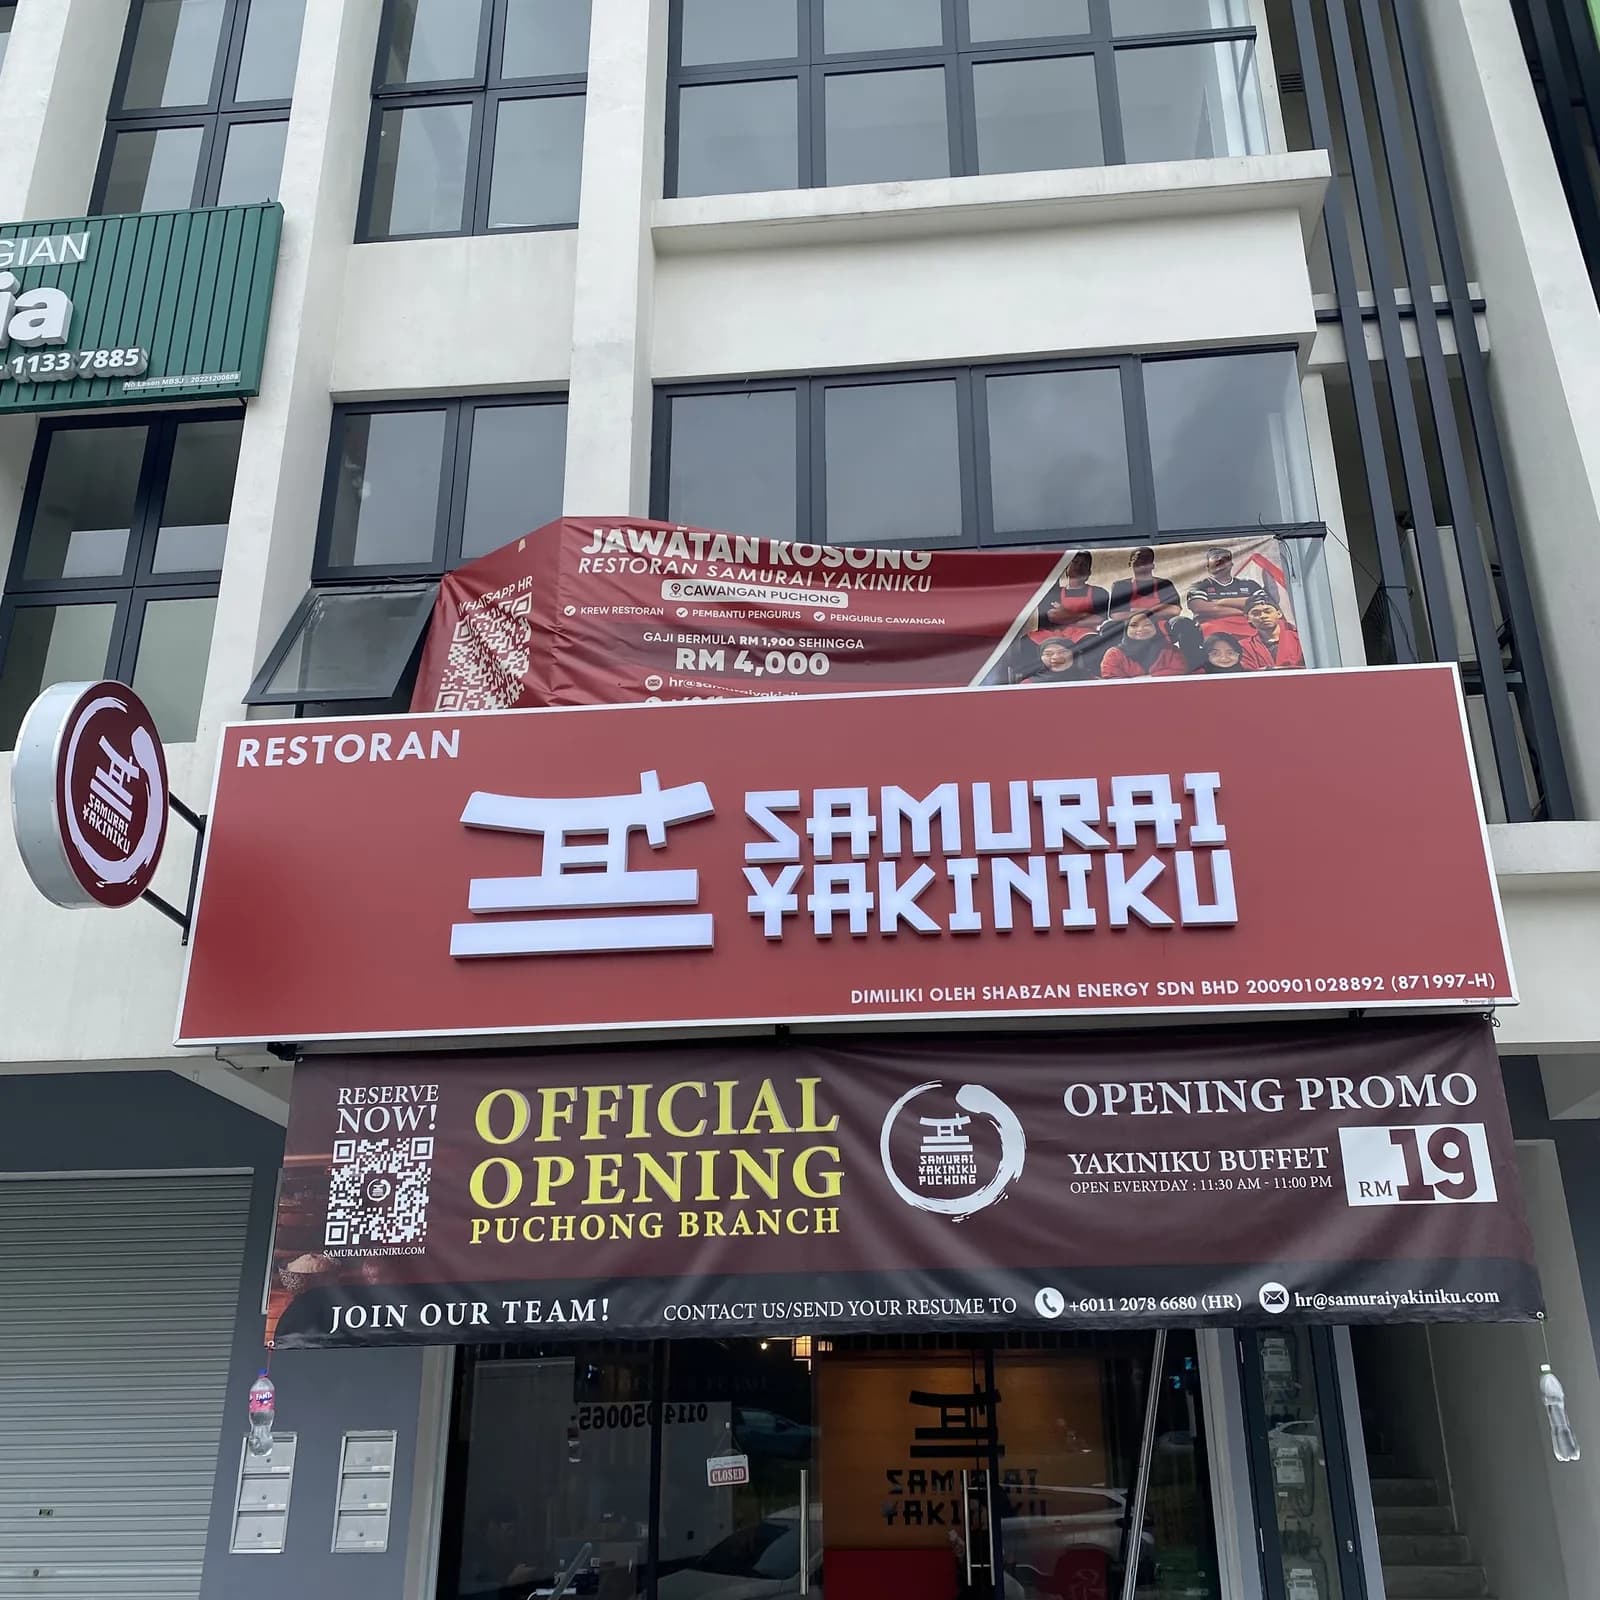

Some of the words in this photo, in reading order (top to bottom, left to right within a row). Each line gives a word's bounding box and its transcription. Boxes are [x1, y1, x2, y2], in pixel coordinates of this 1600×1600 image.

[12, 352, 71, 374] 1133
[79, 348, 140, 370] 7885
[581, 528, 759, 564] JAWATAN
[769, 540, 932, 571] KOSONG
[518, 575, 533, 593] HR
[578, 557, 698, 575] RESTORAN
[706, 564, 812, 587] SAMURAI
[822, 571, 932, 593] YAKINIKU
[683, 584, 766, 599] CAWANGAN
[770, 590, 840, 605] PUCHONG
[580, 606, 609, 616] KREW
[612, 606, 664, 616] RESTORAN
[692, 609, 746, 619] PEMBANTU
[747, 609, 801, 620] PENGURUS
[830, 613, 883, 624] PENGURUS
[884, 617, 945, 625] CAWANGAN
[643, 631, 674, 644] GAJI
[677, 633, 736, 646] BERMULA
[739, 635, 758, 646] RM
[761, 636, 795, 649] 1,900
[798, 637, 865, 650] SEHINGGA
[675, 648, 725, 672] RM
[733, 650, 830, 677] 4,000
[236, 729, 461, 768] RESTORAN
[88, 793, 129, 835] SAMURAI
[744, 772, 1227, 864] SAMURAI
[83, 804, 131, 854] YAKINIKU
[741, 849, 1239, 940] YAKINIKU
[851, 987, 923, 1004] DIMILIKI
[929, 986, 976, 1002] OLEH
[982, 984, 1071, 1000] SHABZAN
[1077, 982, 1150, 998] ENERGY
[1157, 980, 1195, 997] SDN
[1201, 980, 1239, 995] BHD
[1247, 976, 1385, 994] 200901028892
[1391, 972, 1496, 993] (871997-H)
[336, 1084, 440, 1106] RESERVE
[1063, 1078, 1286, 1117] OPENING
[1295, 1072, 1478, 1111] PROMO
[335, 1104, 438, 1134] NOW!
[474, 1077, 840, 1145] OFFICIAL
[918, 1164, 977, 1175] YAKINIKU
[920, 1154, 974, 1165] SAMURAI
[1068, 1150, 1212, 1176] YAKINIKU
[1219, 1146, 1330, 1171] BUFFET
[1358, 1181, 1393, 1198] RM
[1388, 1127, 1478, 1201] 19
[469, 1145, 845, 1209] OPENING
[918, 1174, 977, 1186] PUCHONG
[1070, 1180, 1111, 1194] OPEN
[1113, 1179, 1188, 1193] EVERYDAY
[1201, 1177, 1233, 1192] 11:30
[1236, 1177, 1261, 1190] AM
[1274, 1176, 1307, 1190] 11:00
[1310, 1175, 1332, 1189] PM
[469, 1212, 664, 1244] PUCHONG
[678, 1206, 840, 1238] BRANCH
[323, 1246, 426, 1258] SAMURAIYAKINIKU.COM
[664, 1303, 756, 1321] CONTACT
[762, 1300, 844, 1320] US/SEND
[847, 1300, 901, 1318] YOUR
[906, 1297, 985, 1316] RESUME
[989, 1297, 1017, 1314] TO
[1068, 1298, 1116, 1313] +6011
[1119, 1297, 1158, 1312] 2078
[1160, 1296, 1197, 1311] 6680
[1201, 1293, 1242, 1312] (HR)
[1295, 1289, 1500, 1311] hr@samuraiyakiniku.com
[329, 1304, 409, 1334] JOIN
[419, 1302, 490, 1327] OUR
[502, 1298, 610, 1325] TEAM!
[712, 1467, 745, 1482] CLOSED
